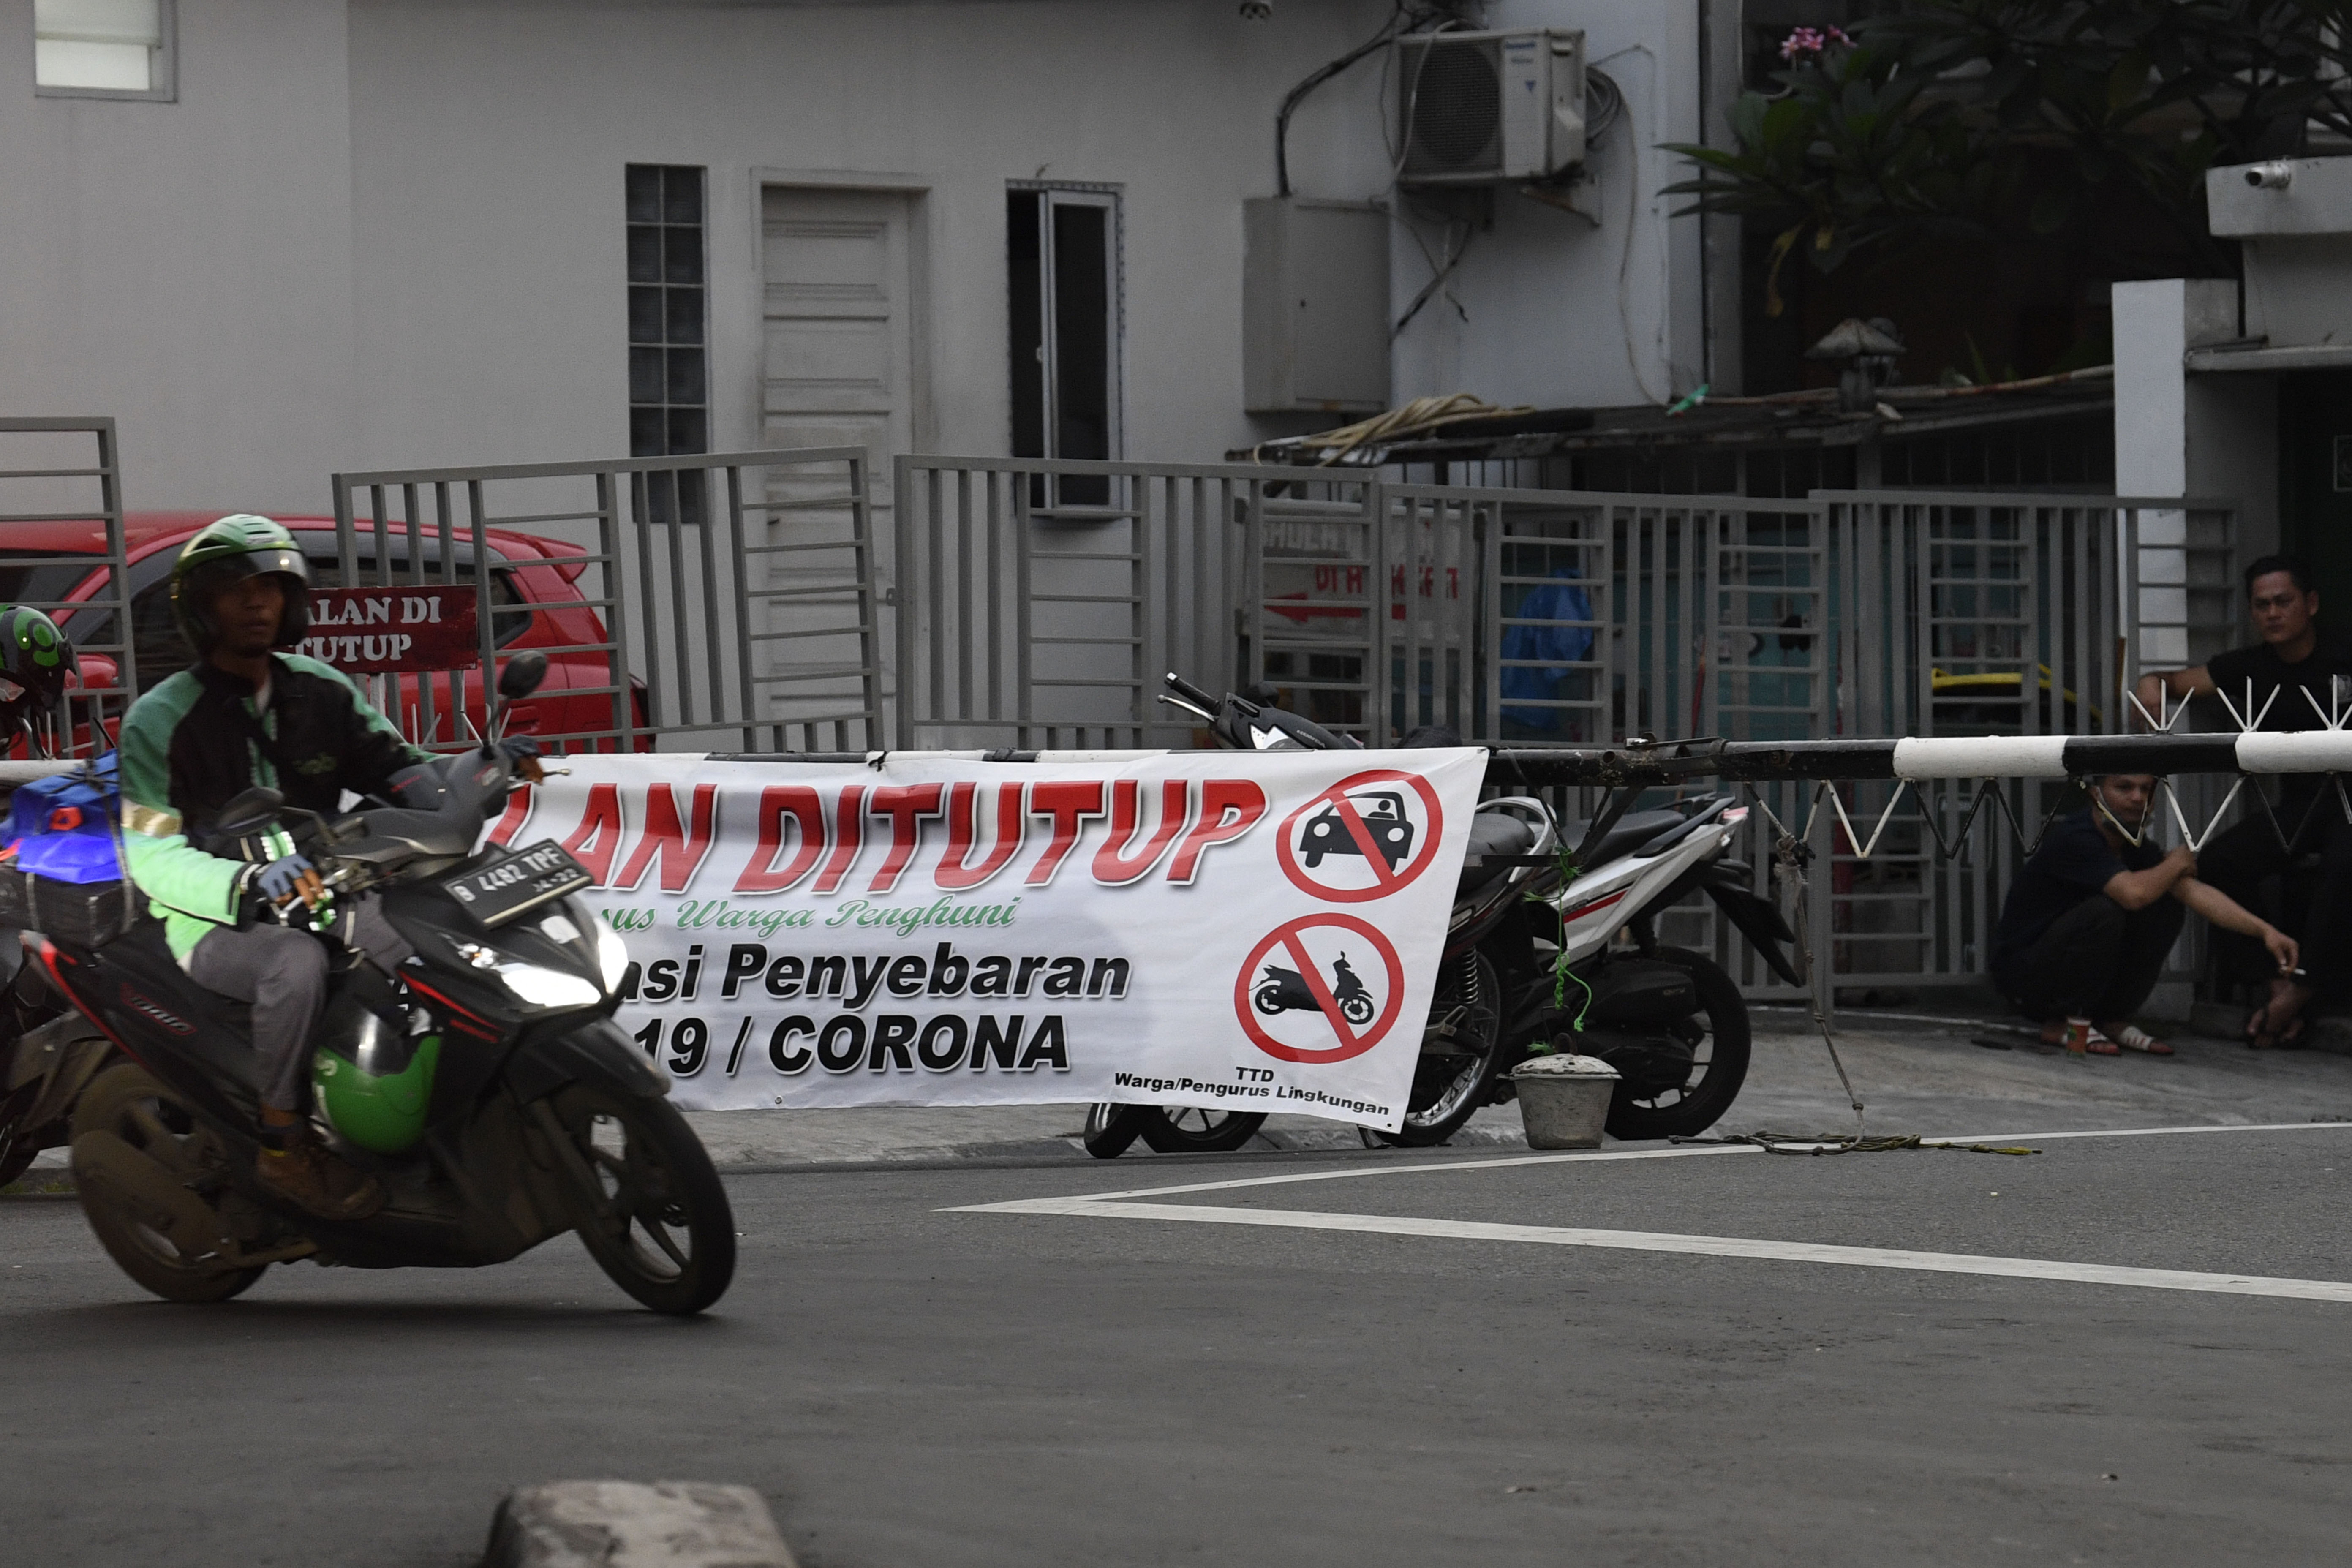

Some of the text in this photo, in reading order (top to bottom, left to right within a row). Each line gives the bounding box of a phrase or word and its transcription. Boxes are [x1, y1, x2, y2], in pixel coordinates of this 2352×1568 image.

[400, 596, 442, 624] DI
[731, 779, 1267, 893] DITUTUP
[677, 900, 815, 938] Warga
[825, 895, 1021, 937] Penghuni
[721, 942, 1131, 1010] Penyebaran
[768, 1014, 1067, 1072] CORONA
[1114, 1073, 1390, 1116] Warga/Pengurus Lingkungan
[1236, 1066, 1274, 1083] TTD
